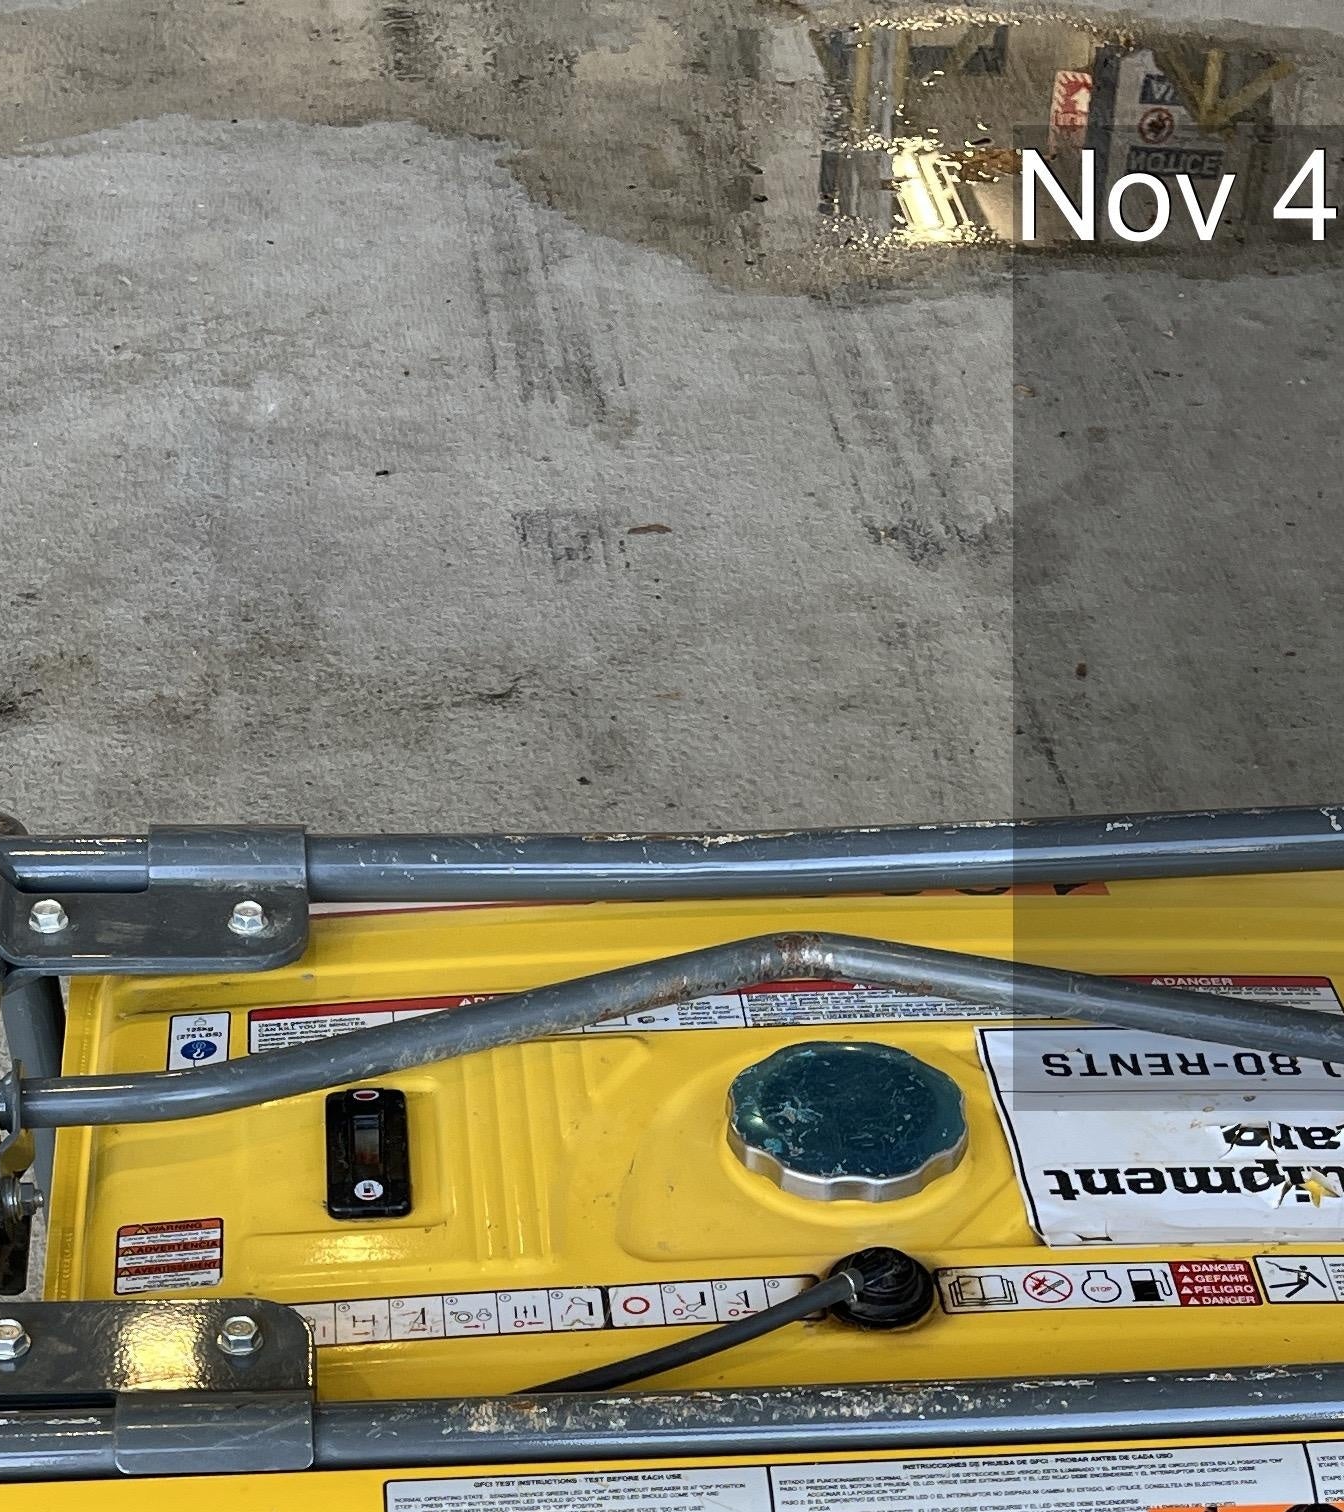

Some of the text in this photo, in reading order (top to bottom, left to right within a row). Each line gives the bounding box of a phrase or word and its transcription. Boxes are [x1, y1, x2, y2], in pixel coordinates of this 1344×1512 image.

[1161, 977, 1234, 986] DANGER
[148, 1223, 202, 1232] WARNING
[136, 1240, 218, 1254] ADVERTENCIA
[1191, 1263, 1245, 1272] DANGER
[1194, 1274, 1248, 1283] GEFAHR
[1194, 1284, 1255, 1294] PELIGRO
[1202, 1296, 1255, 1305] DANGER
